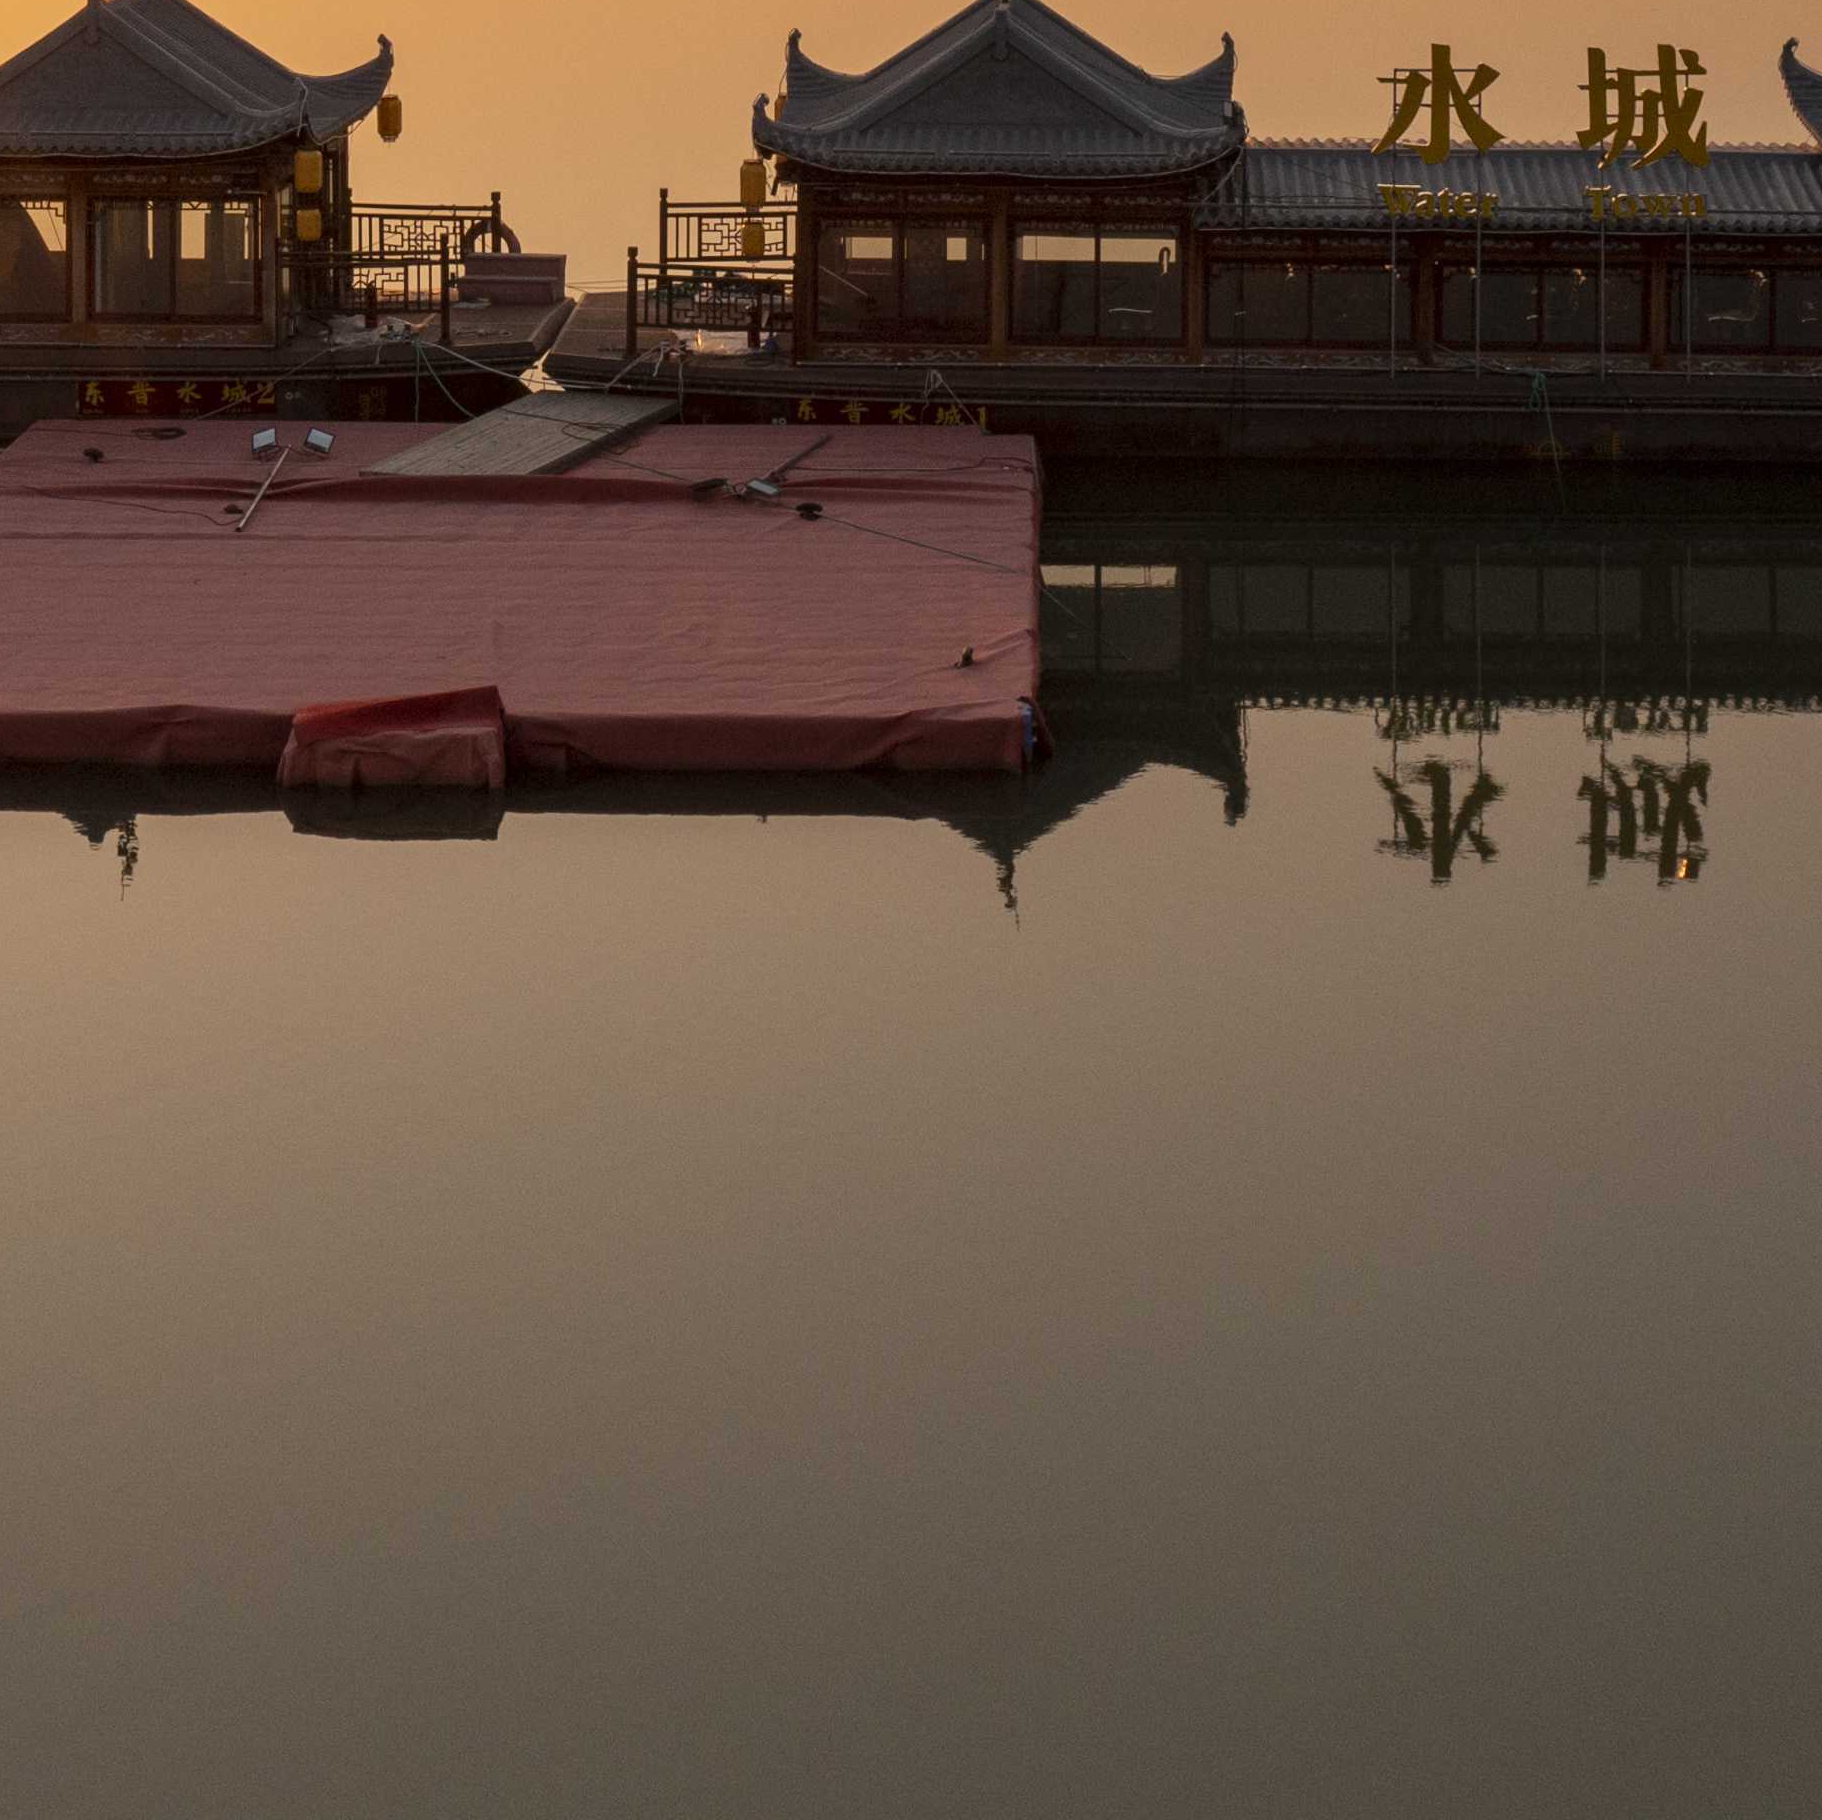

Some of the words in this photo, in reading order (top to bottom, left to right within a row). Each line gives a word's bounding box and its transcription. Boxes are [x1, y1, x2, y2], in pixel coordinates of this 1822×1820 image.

[1371, 43, 1710, 170] 水城
[1377, 183, 1499, 217] Water
[1585, 183, 1706, 220] Town
